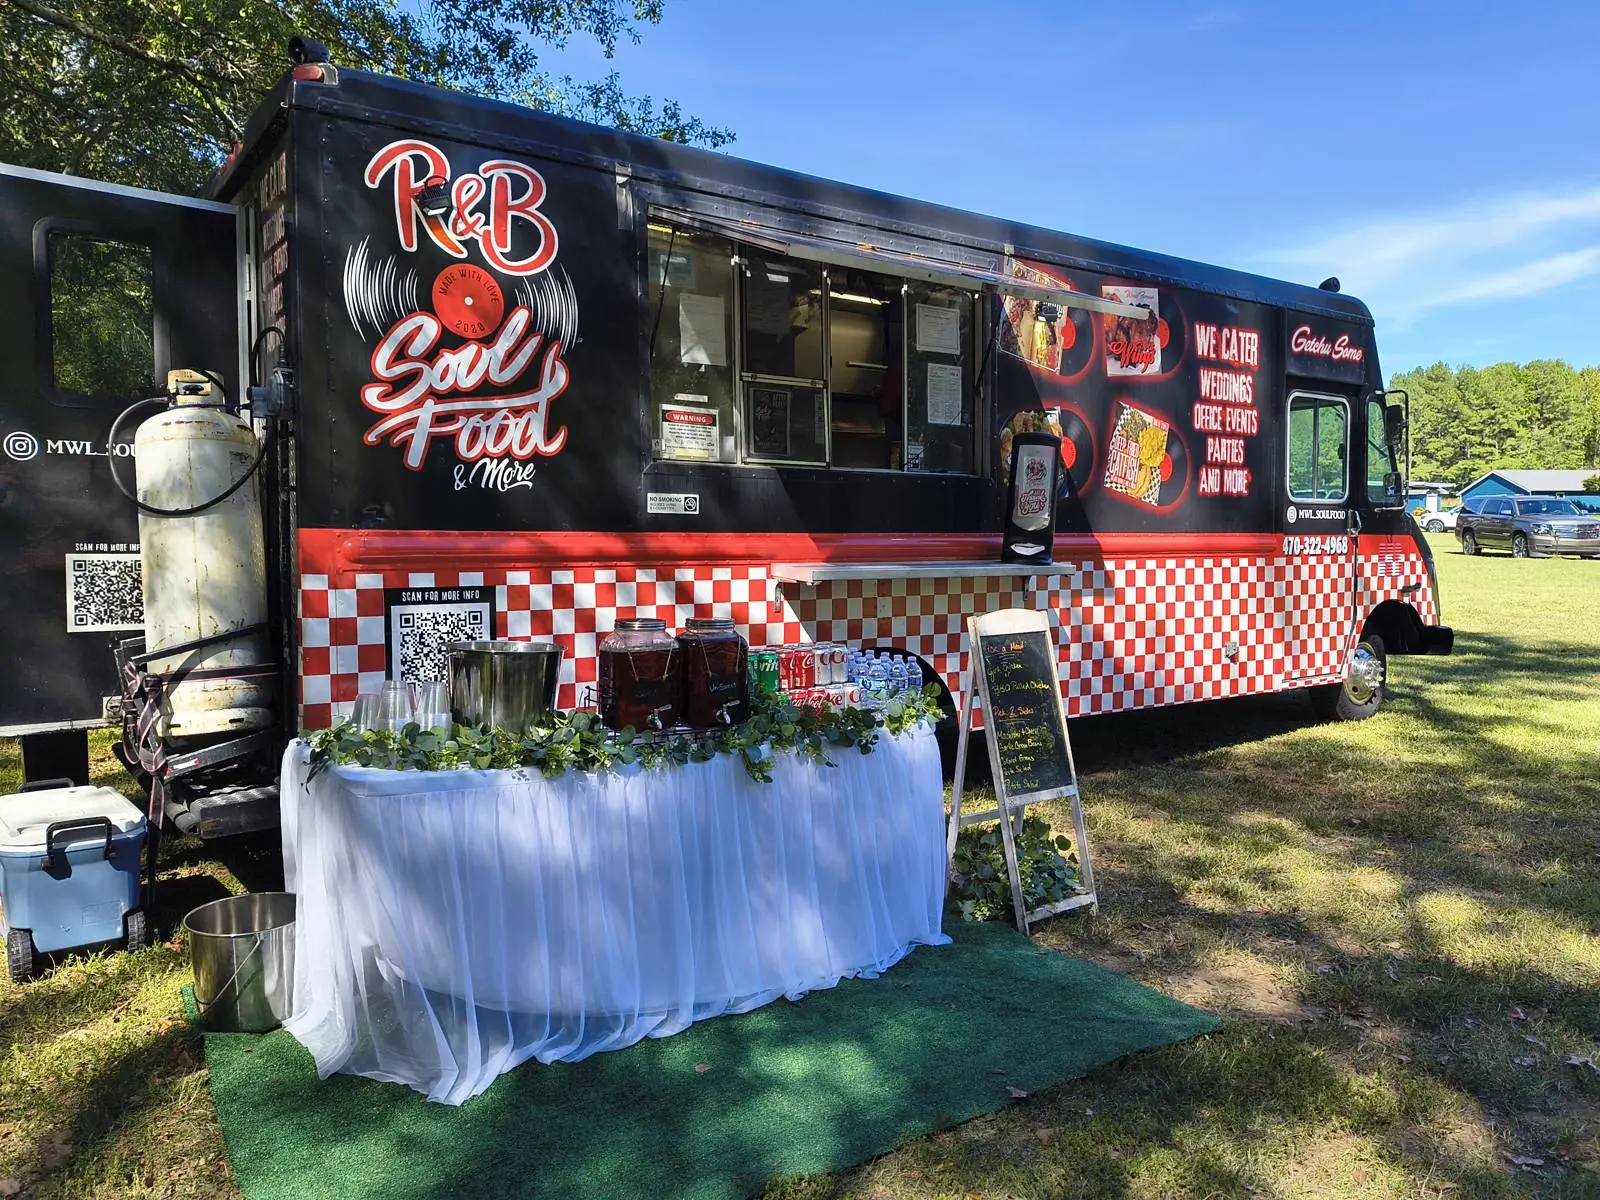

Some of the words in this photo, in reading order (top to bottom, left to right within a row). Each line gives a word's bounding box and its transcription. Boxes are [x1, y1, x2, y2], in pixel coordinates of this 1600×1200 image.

[364, 139, 559, 276] R&B
[439, 272, 456, 296] MADE
[458, 269, 483, 282] WITH
[483, 280, 500, 304] LOVE
[361, 304, 545, 414] Soul
[1195, 324, 1217, 358] WE
[1221, 328, 1259, 367] CATER
[1332, 335, 1362, 361] Some
[1200, 369, 1253, 404] WEDDINGS
[362, 341, 570, 471] Food
[672, 413, 706, 423] WARNING
[1194, 403, 1223, 431] OFFICE
[1226, 407, 1258, 434] EVENTS
[1207, 437, 1245, 464] PARTIES
[453, 464, 468, 491] &
[467, 457, 537, 492] More
[1109, 449, 1140, 486] CATFISH
[1200, 467, 1220, 493] AND
[1223, 468, 1248, 494] MORE
[75, 543, 93, 551] SCAN
[96, 543, 108, 551] FOR
[110, 543, 127, 552] MORE
[1283, 536, 1349, 556] 470-322-4968
[401, 591, 422, 602] SCAN
[424, 591, 439, 601] FOR
[441, 590, 460, 601] MORE
[463, 590, 480, 600] INFO
